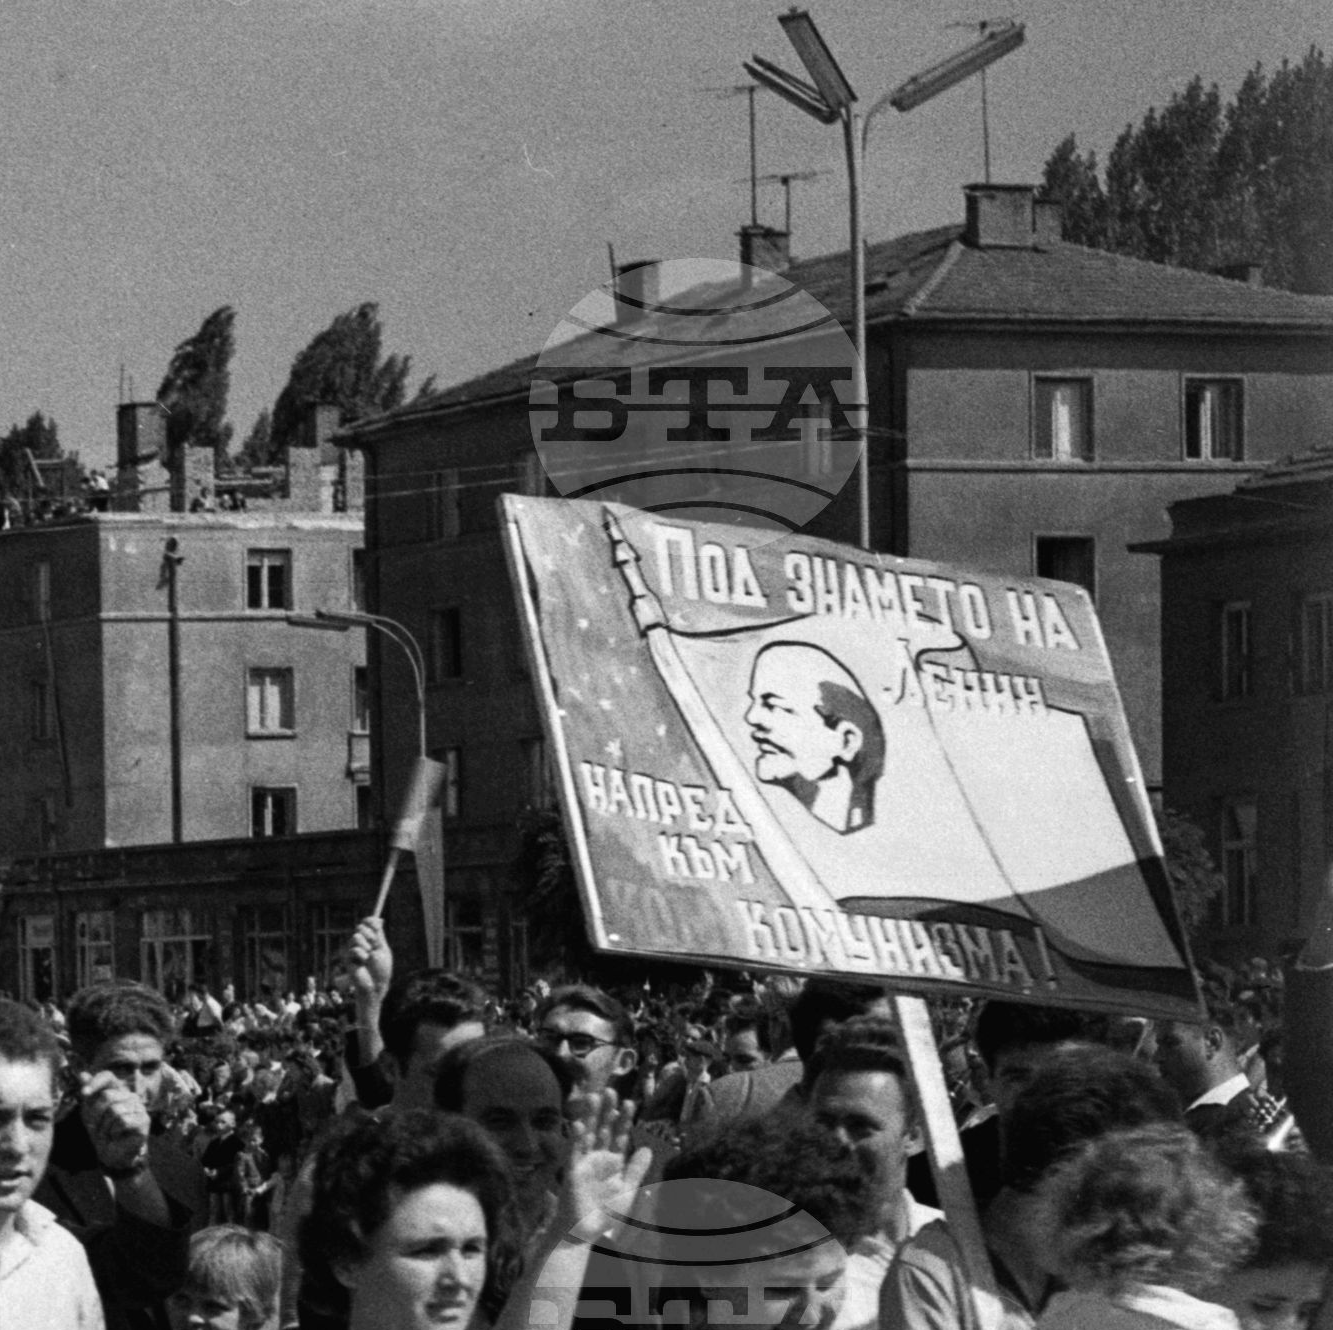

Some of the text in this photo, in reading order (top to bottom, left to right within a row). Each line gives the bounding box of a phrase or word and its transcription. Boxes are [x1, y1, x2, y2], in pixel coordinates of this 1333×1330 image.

[784, 550, 992, 640] ЗНАМЕТО
[1006, 586, 1082, 651] НА
[883, 636, 1049, 714] ЛЕНИН
[581, 760, 754, 836] НАПРЕД
[658, 831, 756, 884] КЪМ
